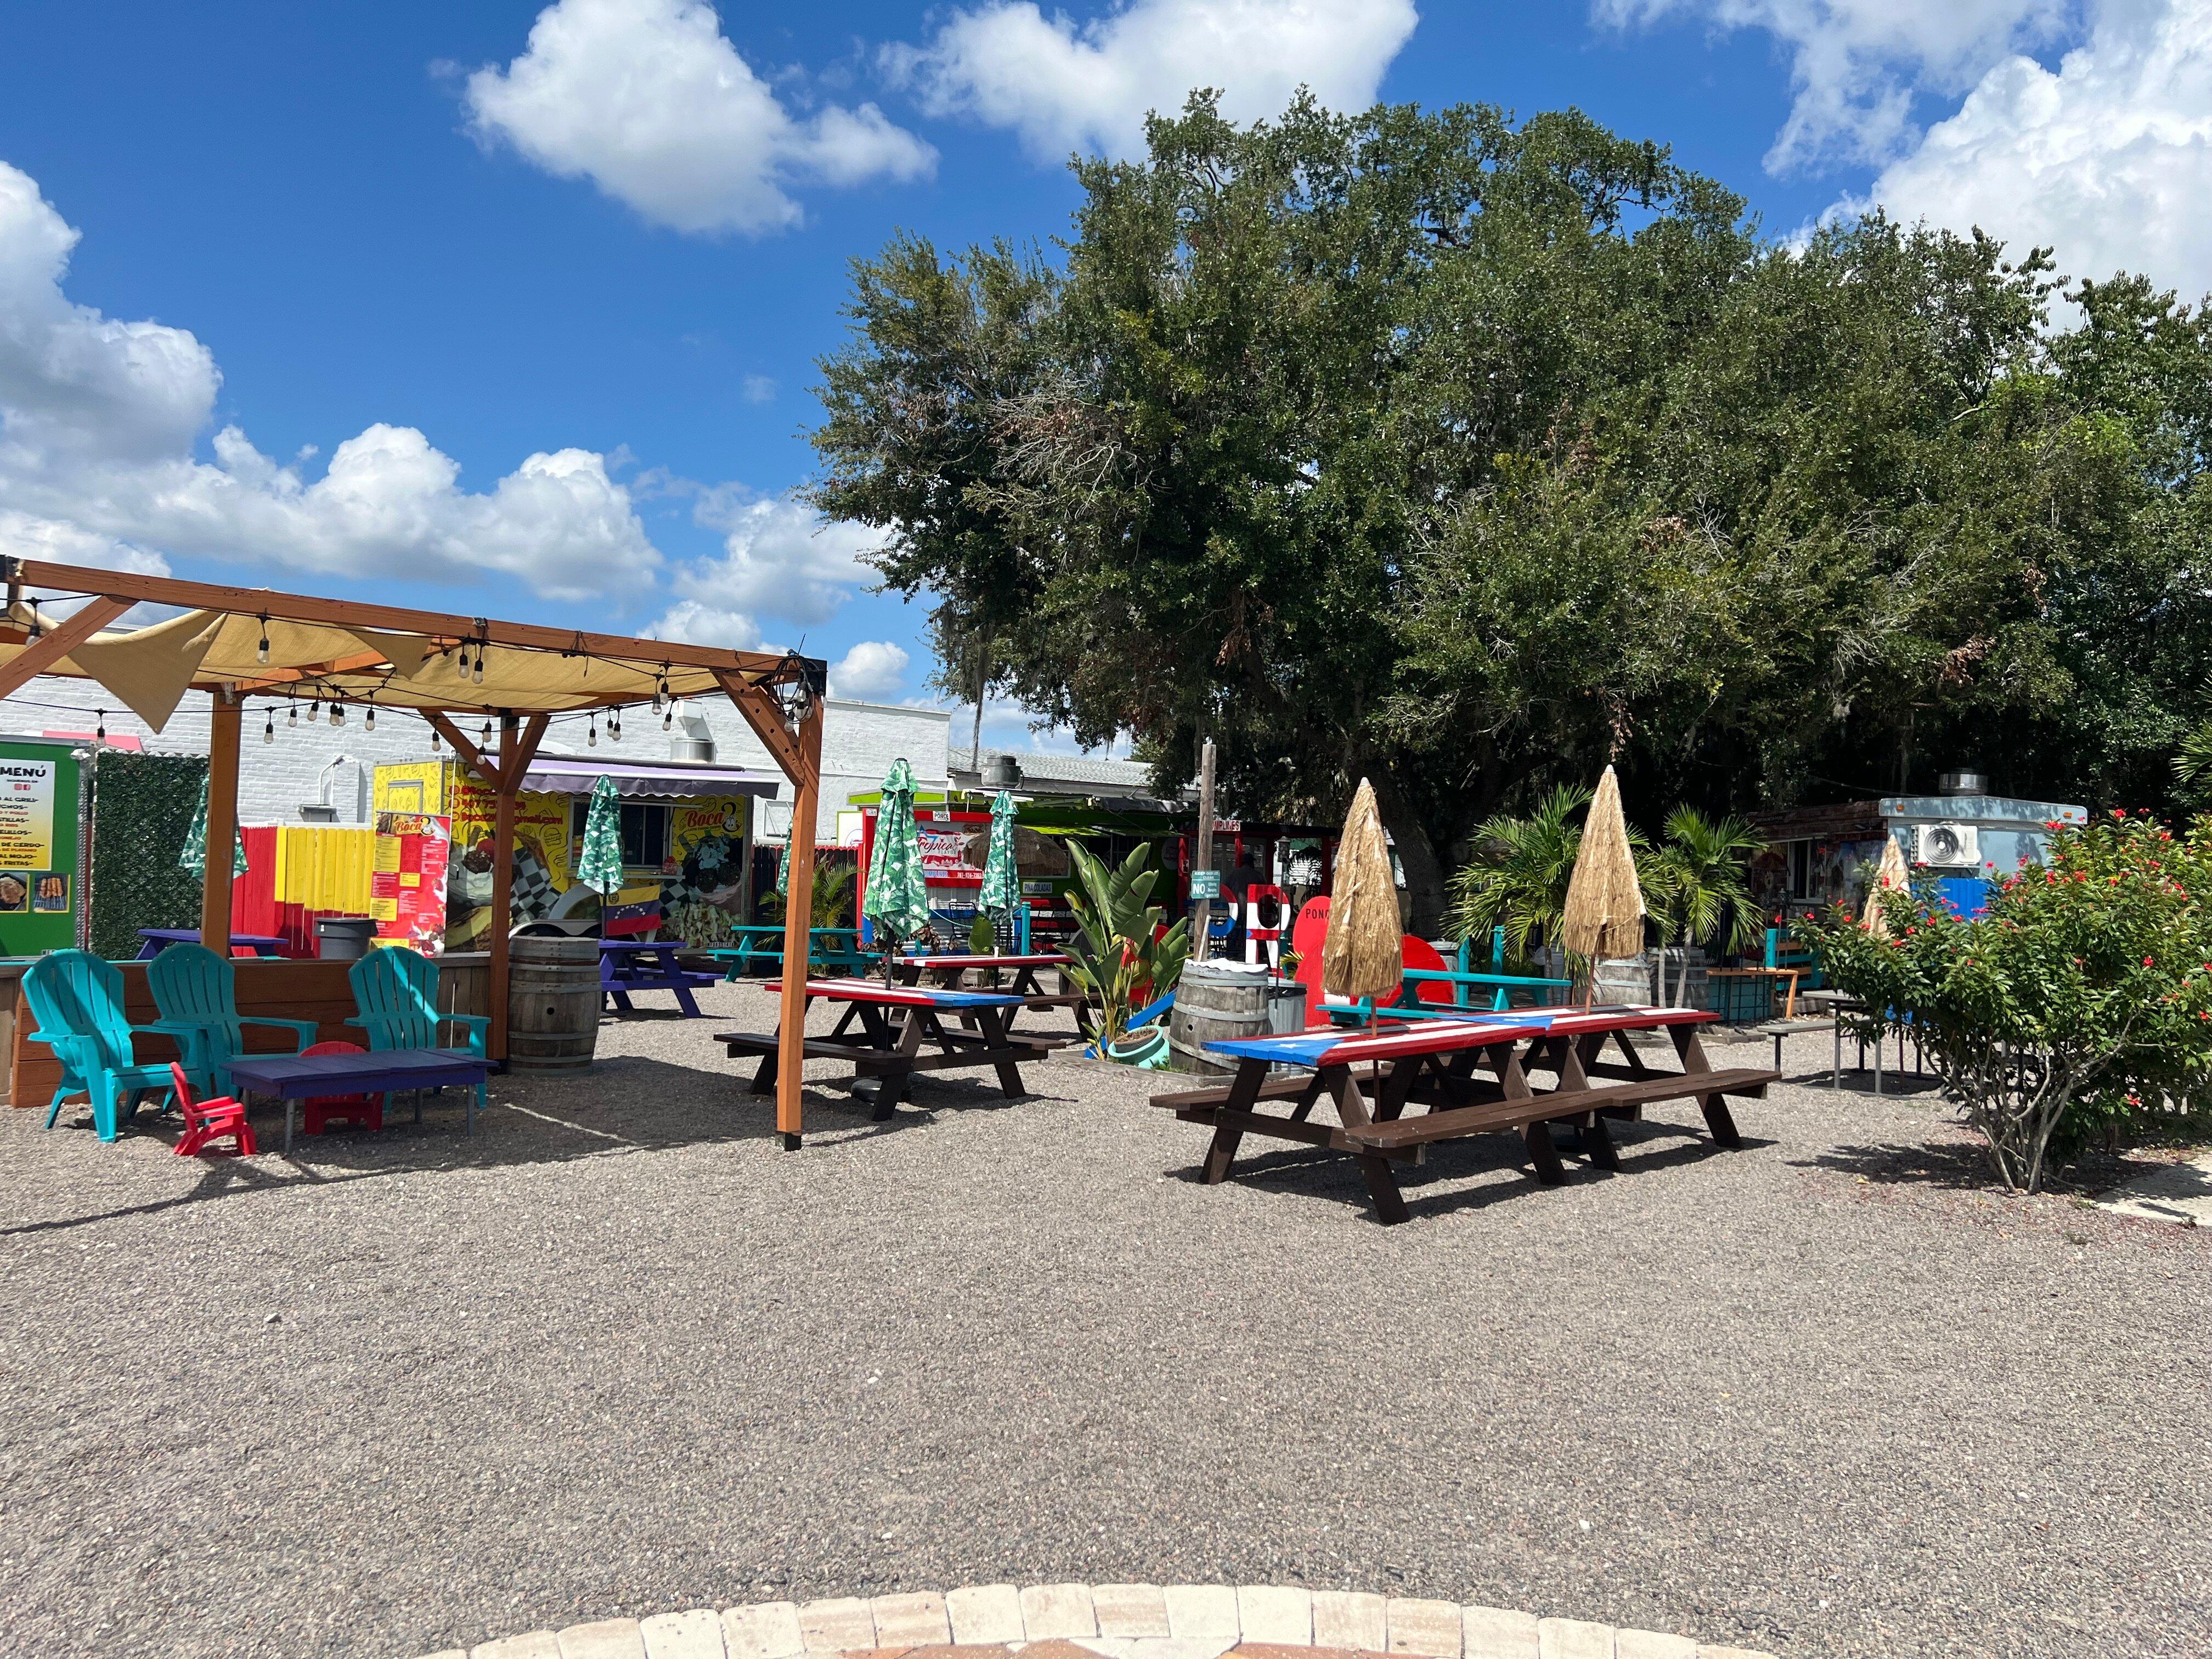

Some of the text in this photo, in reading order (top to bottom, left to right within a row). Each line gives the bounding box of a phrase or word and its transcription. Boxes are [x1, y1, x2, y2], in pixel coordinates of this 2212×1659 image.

[0, 765, 46, 777] MENÚ
[685, 810, 724, 827] Boca
[396, 822, 422, 831] Boca
[1213, 820, 1239, 830] MPLINES
[1034, 883, 1051, 892] COLADAS
[1193, 883, 1205, 894] NO
[1306, 909, 1330, 919] PONC
